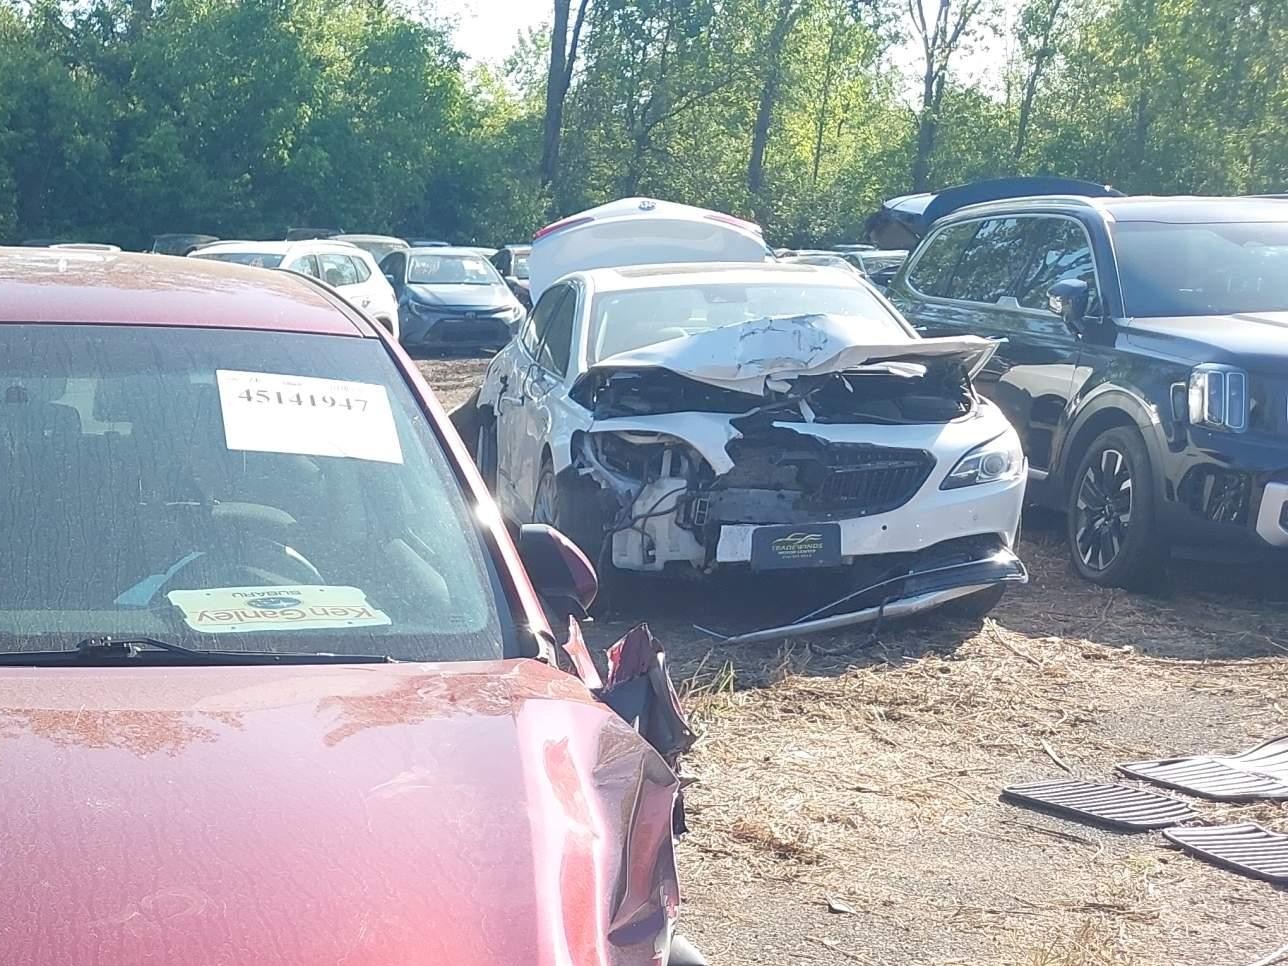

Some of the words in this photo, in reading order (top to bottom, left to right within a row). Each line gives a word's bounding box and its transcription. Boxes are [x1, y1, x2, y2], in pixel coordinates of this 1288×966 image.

[237, 387, 369, 412] 45141947
[231, 590, 302, 598] SUBARU
[197, 607, 307, 622] Ganley
[310, 606, 374, 619] Ken
